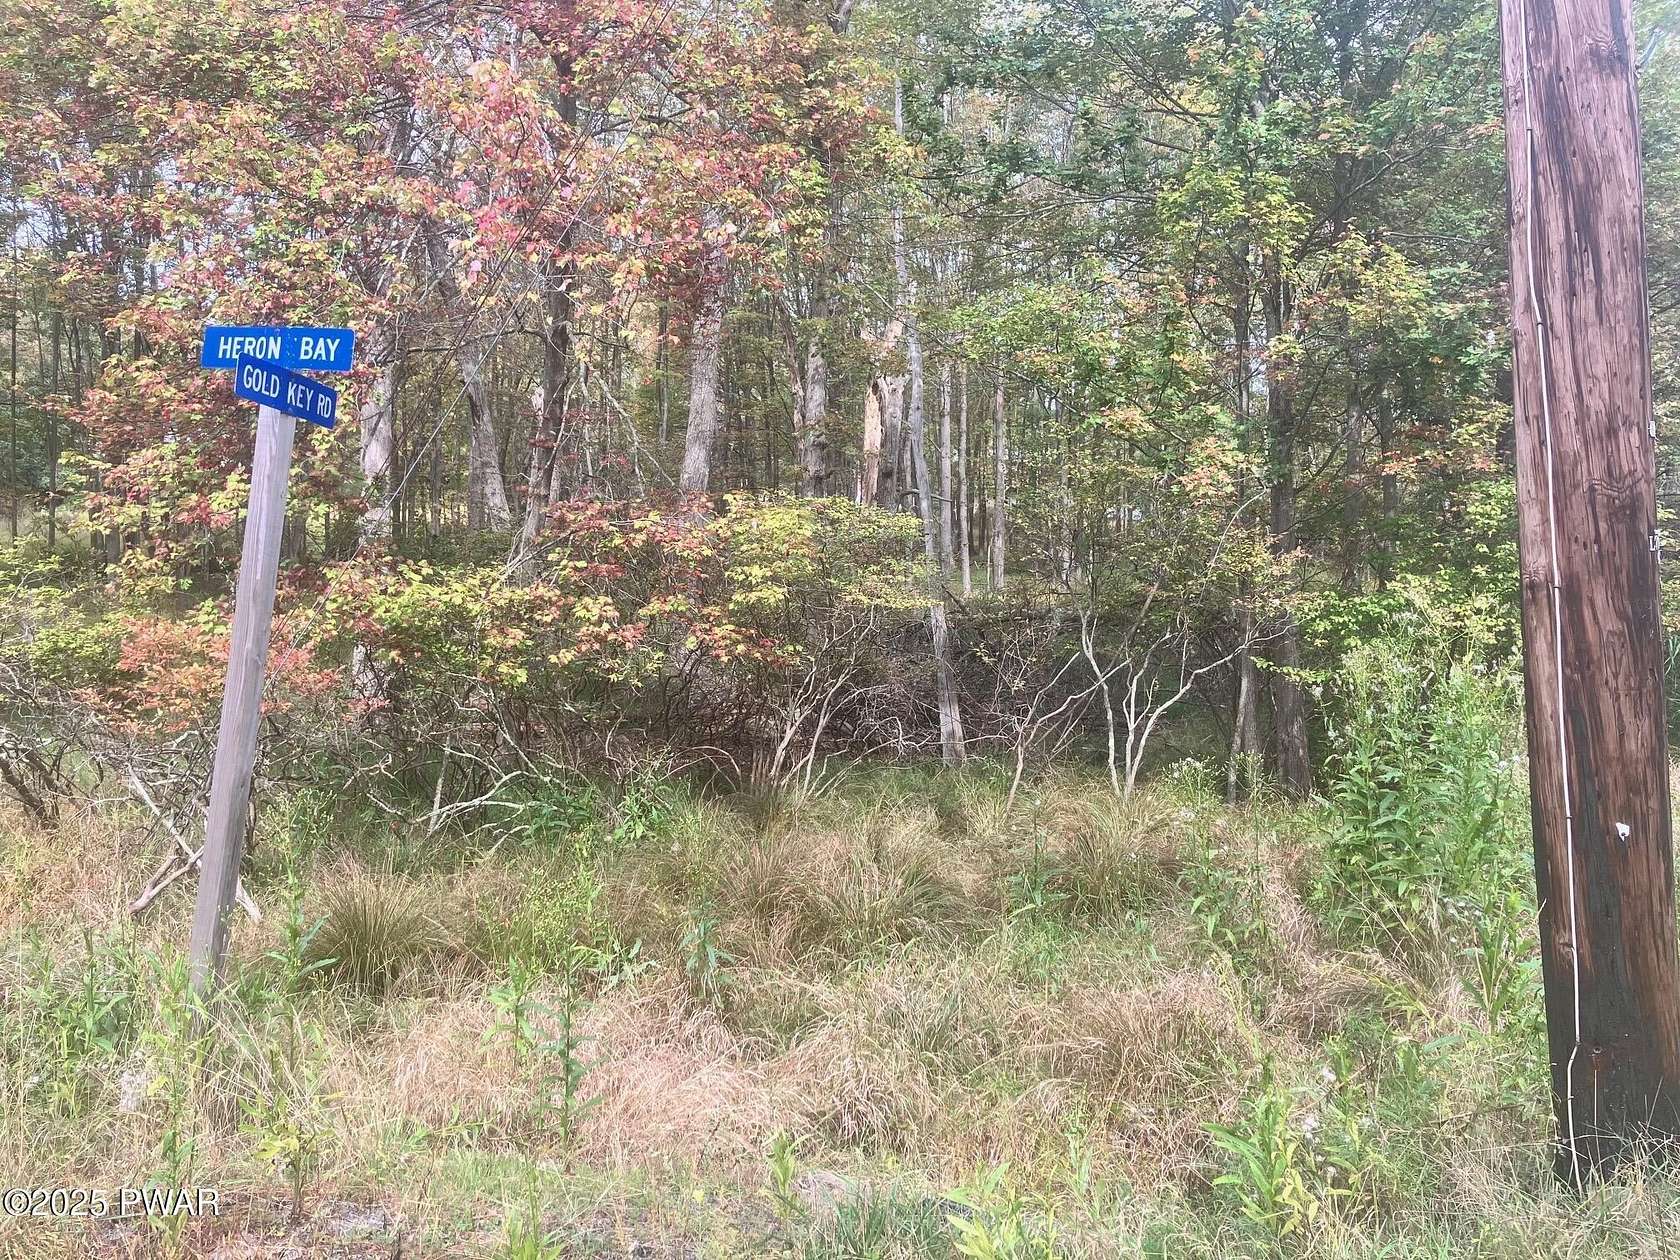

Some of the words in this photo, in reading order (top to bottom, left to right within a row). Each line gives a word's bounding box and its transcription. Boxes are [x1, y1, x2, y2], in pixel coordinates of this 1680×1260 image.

[218, 336, 282, 360] HERON
[300, 337, 341, 362] BAY
[243, 364, 280, 398] GOLD
[287, 381, 314, 411] KEY
[316, 393, 332, 419] RD
